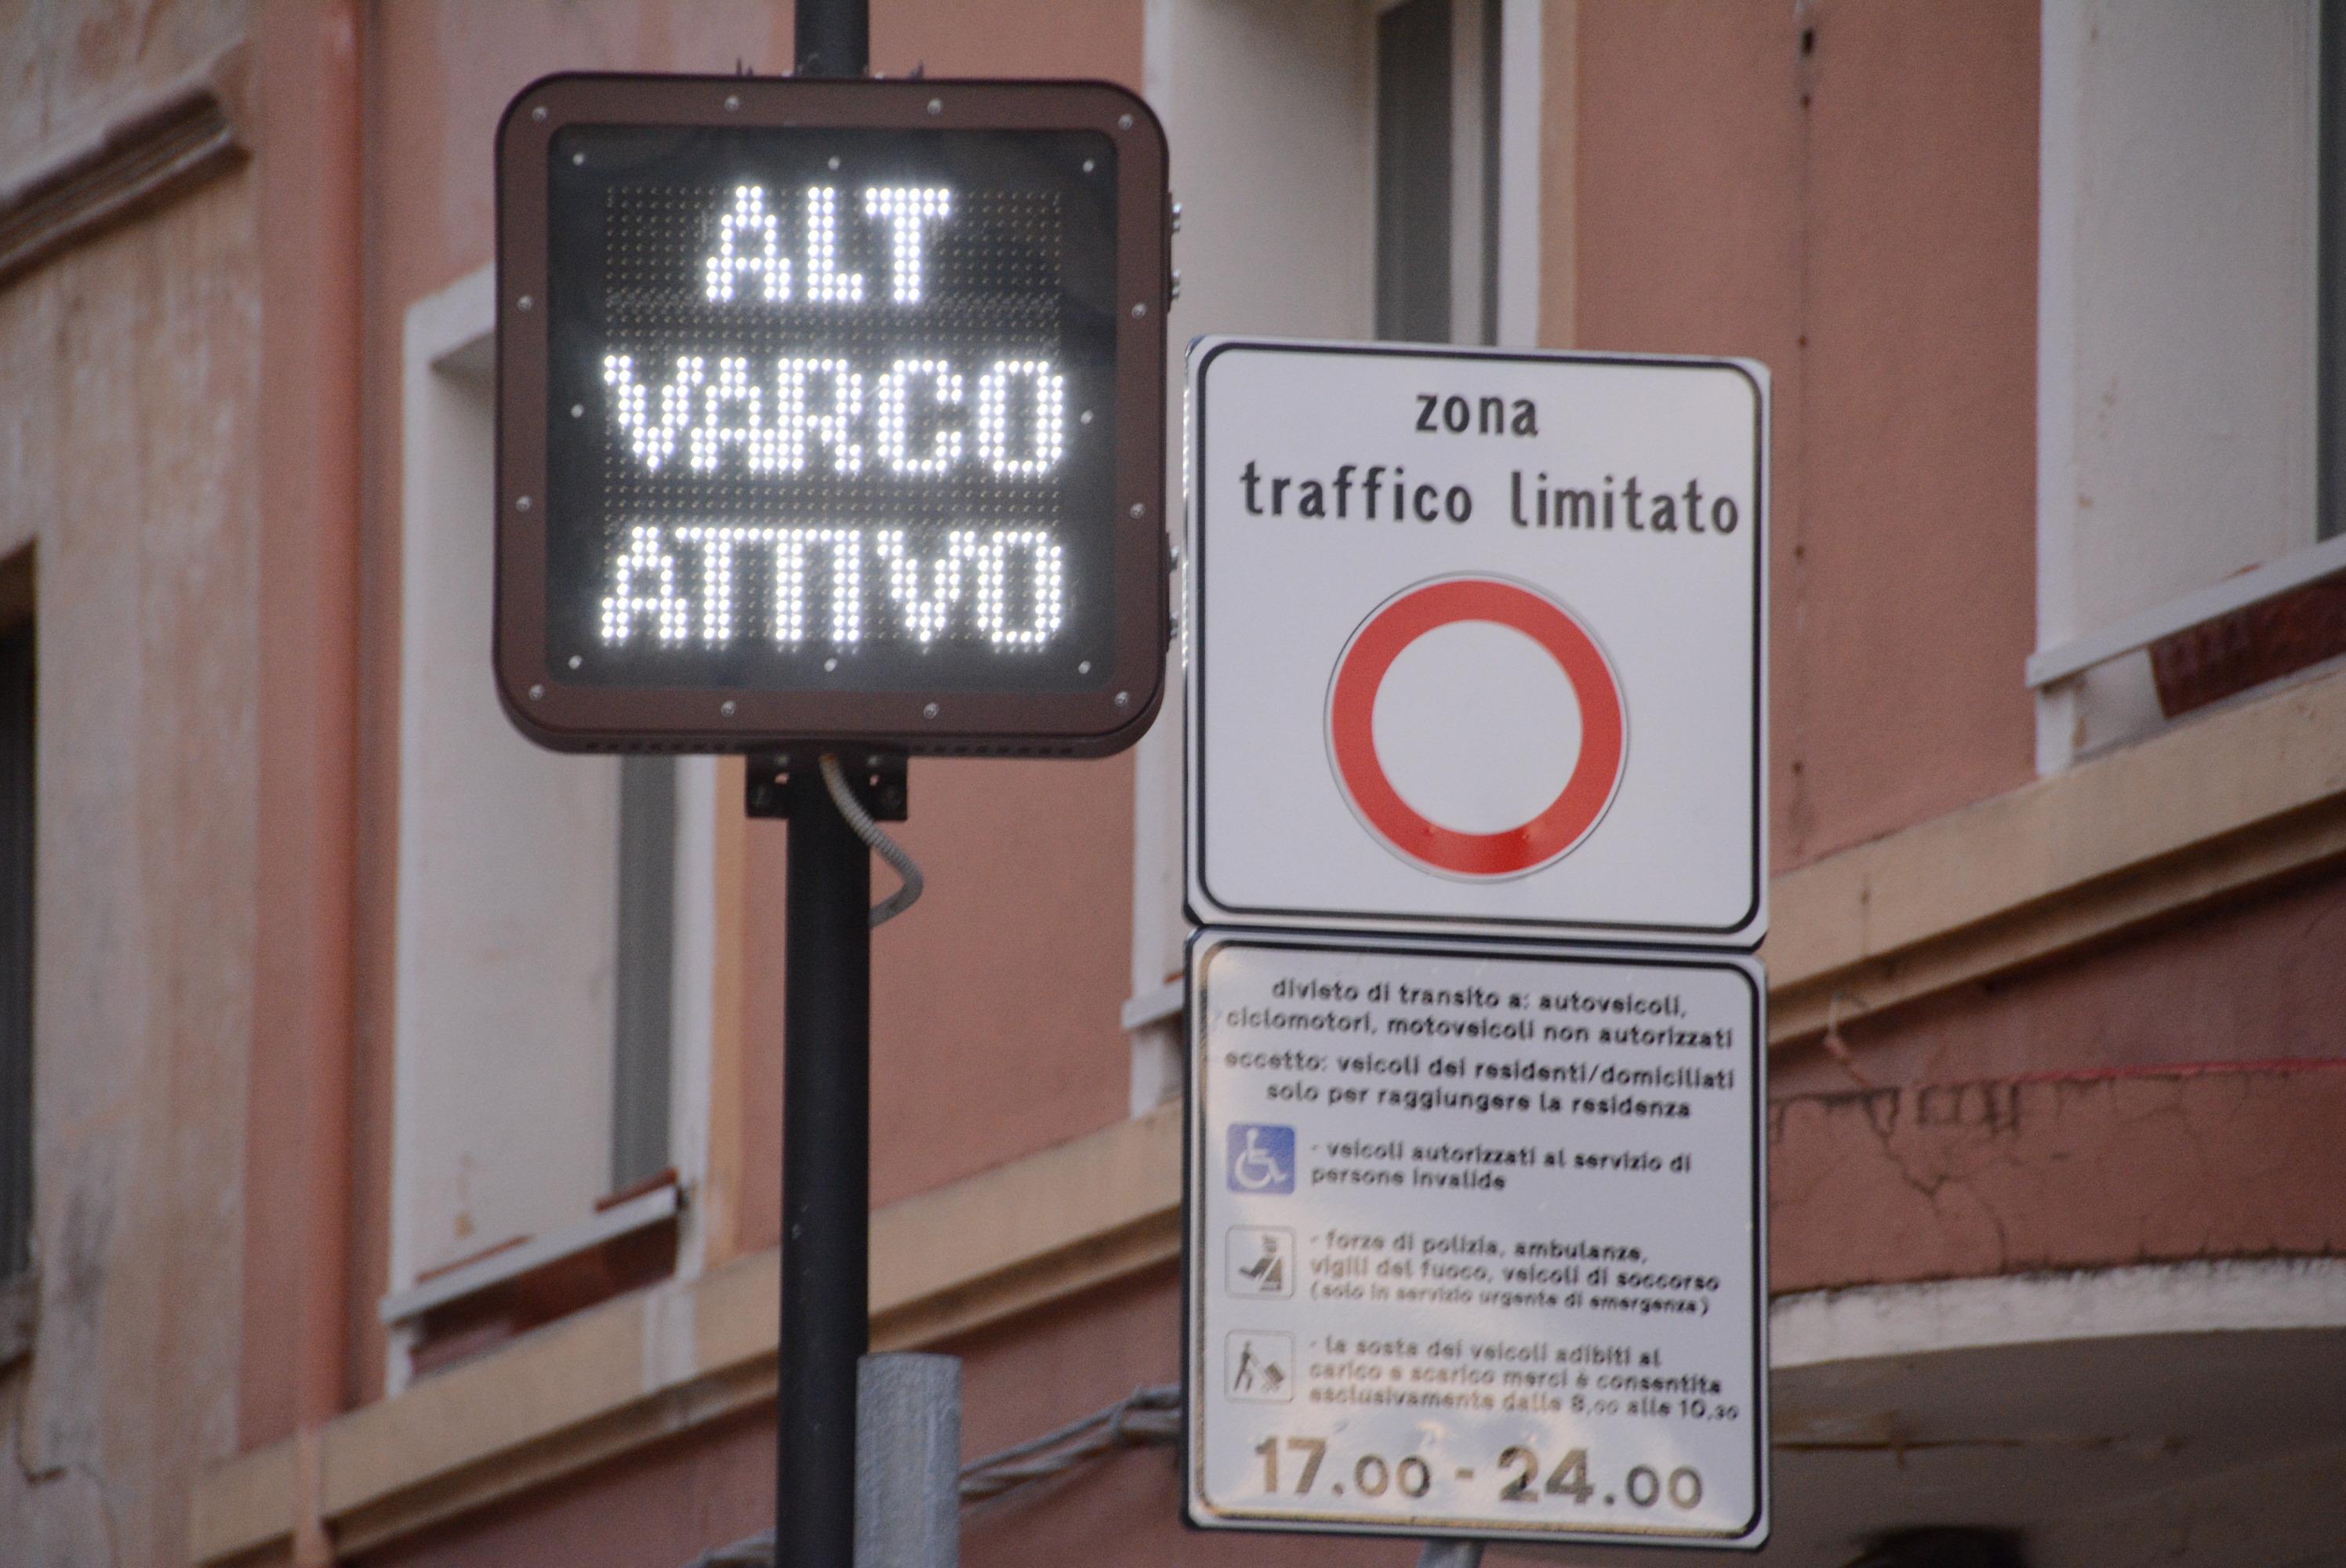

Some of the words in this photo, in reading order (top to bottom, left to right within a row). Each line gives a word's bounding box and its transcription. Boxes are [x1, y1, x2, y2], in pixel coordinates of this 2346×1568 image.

[706, 182, 952, 303] ALT
[604, 354, 1065, 473] VARCO
[1414, 394, 1538, 437] zona
[1240, 459, 1473, 523] traffico
[1510, 470, 1738, 535] limitato
[602, 525, 1062, 644] ATTIVO
[1272, 978, 1358, 1000] divieto
[1367, 982, 1389, 1002] di
[1400, 983, 1498, 1007] transito
[1509, 993, 1529, 1010] a:
[1539, 991, 1686, 1018] autoveicoli,
[1226, 1006, 1377, 1034] ciclomotori,
[1387, 1017, 1533, 1039] motoveicoli
[1544, 1024, 1589, 1043] non
[1599, 1024, 1731, 1048] autorizzati
[1226, 1050, 1327, 1073] eccetto:
[1338, 1053, 1419, 1076] veicoli
[1427, 1056, 1465, 1077] dei
[1475, 1058, 1734, 1089] residenti/domiciliati
[1266, 1080, 1319, 1102] solo
[1328, 1086, 1367, 1105] per
[1378, 1087, 1529, 1112] raggiungere
[1539, 1092, 1561, 1112] la
[1571, 1094, 1690, 1118] residenza
[1327, 1141, 1403, 1159] veicoli
[1413, 1144, 1535, 1166] autorizzati
[1544, 1148, 1565, 1167] al
[1574, 1149, 1661, 1171] servizio
[1669, 1152, 1690, 1173] di
[1311, 1167, 1404, 1186] persone
[1413, 1167, 1505, 1190] invalide
[1327, 1229, 1385, 1250] forze
[1393, 1232, 1414, 1251] di
[1423, 1235, 1505, 1258] polizia,
[1516, 1239, 1647, 1264] ambulanze,
[1310, 1257, 1367, 1277] vigili
[1378, 1259, 1413, 1276] del
[1421, 1259, 1493, 1283] fuoco,
[1503, 1264, 1578, 1285] veicoli
[1588, 1267, 1607, 1287] di
[1618, 1272, 1720, 1291] soccorso
[1311, 1281, 1363, 1301] (solo
[1371, 1283, 1389, 1300] in
[1396, 1284, 1472, 1303] servizio
[1480, 1290, 1557, 1308] urgente
[1564, 1291, 1582, 1308] di
[1326, 1334, 1346, 1355] la
[1356, 1338, 1418, 1357] sosta
[1428, 1338, 1462, 1359] dei
[1471, 1341, 1547, 1363] veicoli
[1556, 1344, 1630, 1366] adibiti
[1639, 1347, 1661, 1367] al
[1310, 1359, 1380, 1380] carico
[1389, 1366, 1401, 1381] e
[1411, 1364, 1494, 1385] scarico
[1503, 1369, 1567, 1388] merci
[1596, 1372, 1721, 1395] consentita
[1309, 1385, 1494, 1410] esclusivamente
[1502, 1390, 1561, 1412] dalle
[1627, 1396, 1671, 1417] alle
[1255, 1435, 1430, 1499] 17.00
[1497, 1446, 1703, 1511] 24.00
